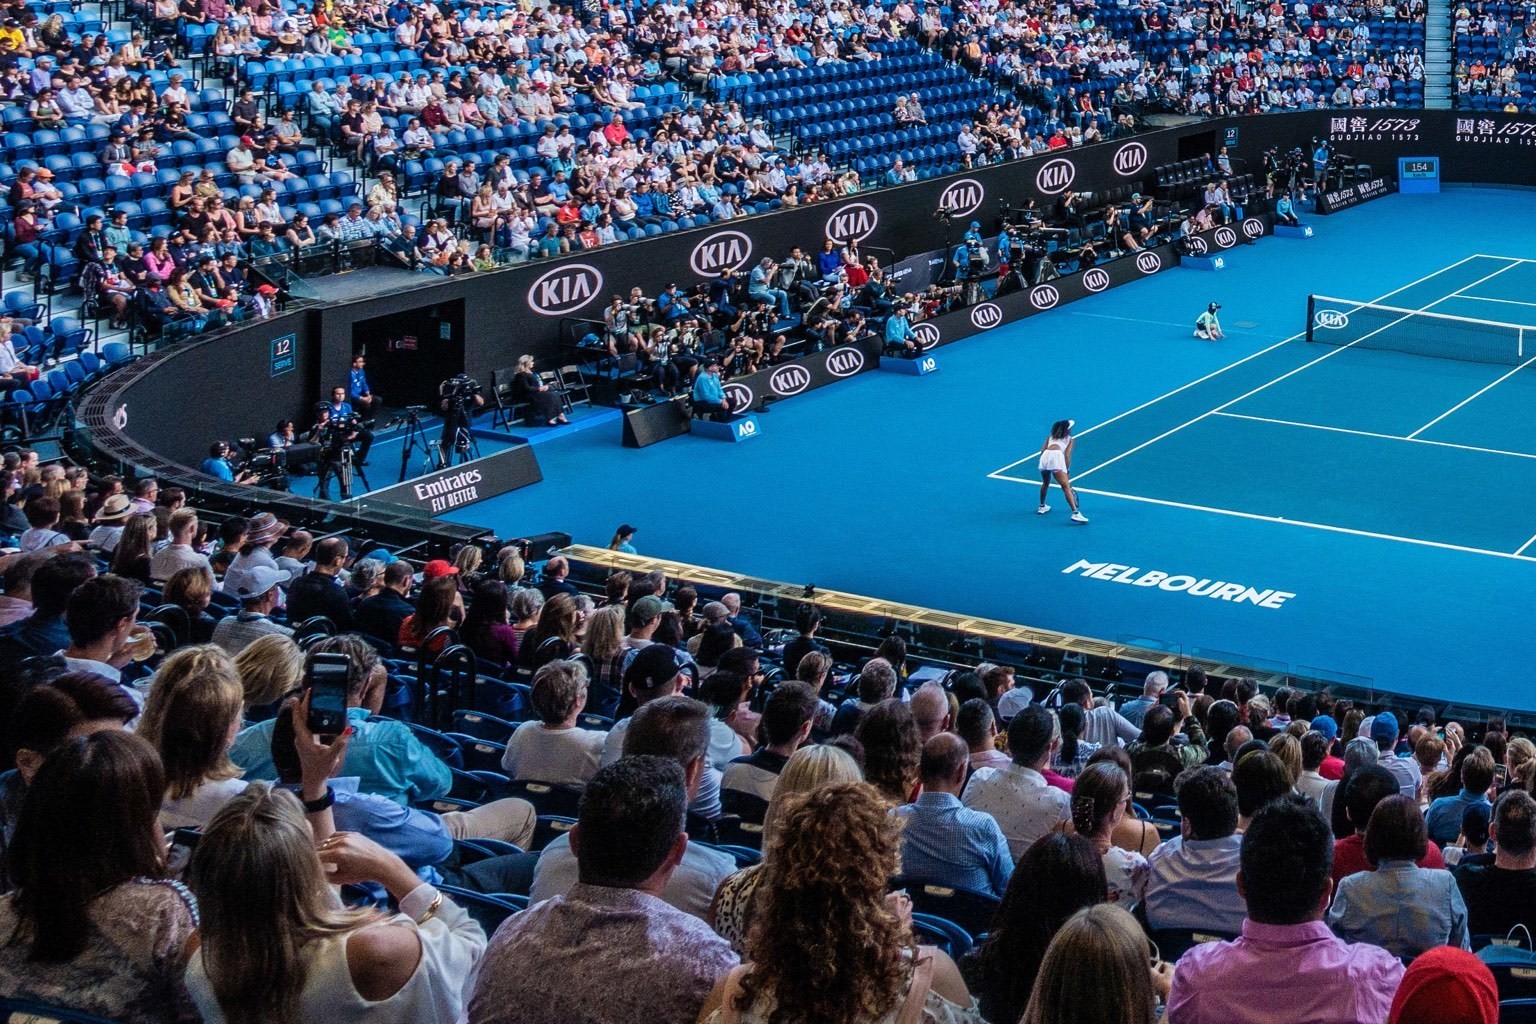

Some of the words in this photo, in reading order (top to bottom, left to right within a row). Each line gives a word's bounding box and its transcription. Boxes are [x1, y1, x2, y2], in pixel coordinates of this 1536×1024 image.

[1226, 129, 1235, 138] 12
[1456, 136, 1510, 144] GUOJIAO
[1120, 148, 1141, 170] KIA
[1412, 163, 1427, 171] 154
[1043, 165, 1068, 188] KIA
[948, 186, 977, 210] KIA
[834, 210, 870, 238] KIA
[1245, 222, 1260, 234] KIA
[1217, 231, 1234, 244] KIA
[701, 239, 742, 269] KIA
[1140, 255, 1158, 270] KIA
[1215, 258, 1224, 267] AO
[1086, 272, 1106, 288] KIA
[542, 273, 591, 307] KIA
[1034, 289, 1055, 305] KIA
[975, 307, 998, 325] KIA
[1321, 313, 1342, 325] KIA
[276, 339, 290, 356] 12
[831, 352, 859, 372] KIA
[922, 358, 936, 371] AO
[775, 369, 805, 391] KIA
[739, 421, 755, 436] AO
[414, 469, 482, 500] Emirates
[432, 495, 448, 512] FLY
[448, 486, 478, 506] BETTER
[1062, 559, 1296, 609] MELBOURNE
